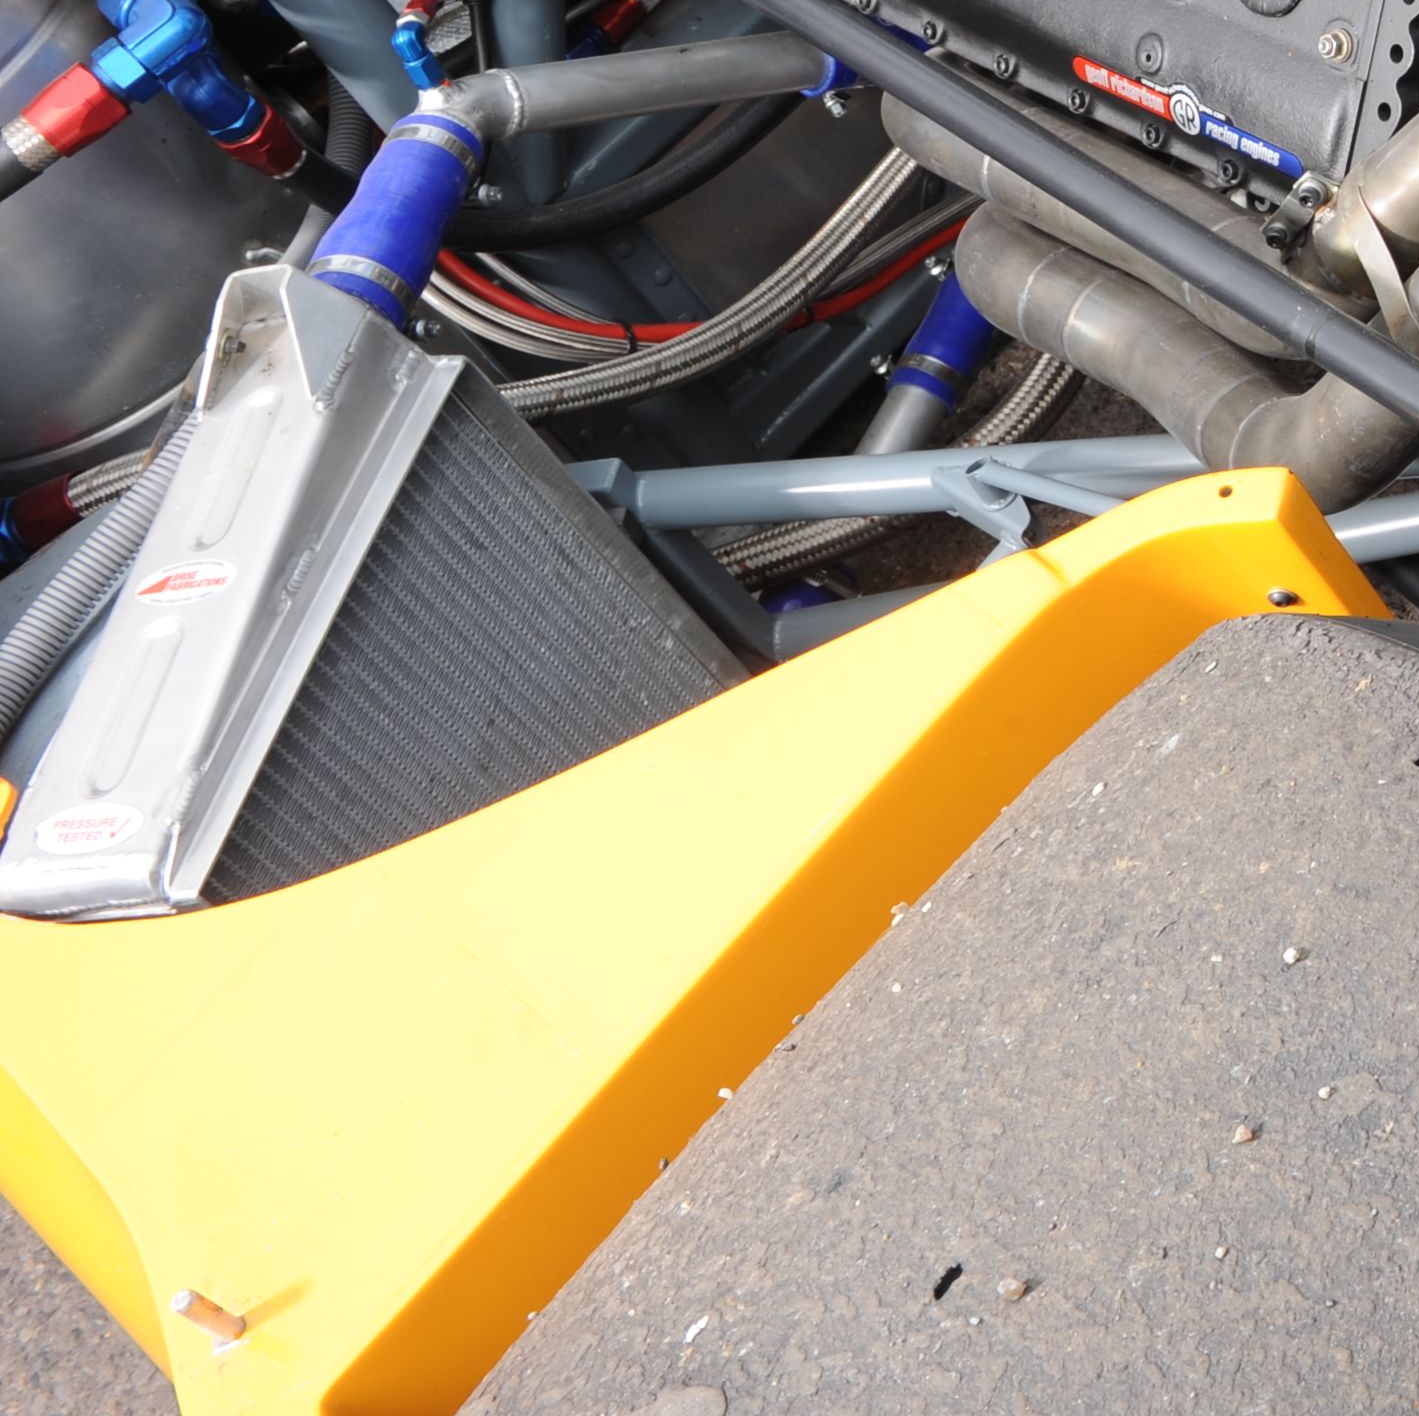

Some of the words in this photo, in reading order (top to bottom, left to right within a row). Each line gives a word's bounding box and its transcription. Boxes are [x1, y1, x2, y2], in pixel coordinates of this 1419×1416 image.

[1110, 72, 1165, 114] richardson
[1205, 119, 1239, 151] racing
[1240, 136, 1280, 167] engines
[52, 817, 118, 830] PRESSURE
[58, 830, 103, 843] TESTED
